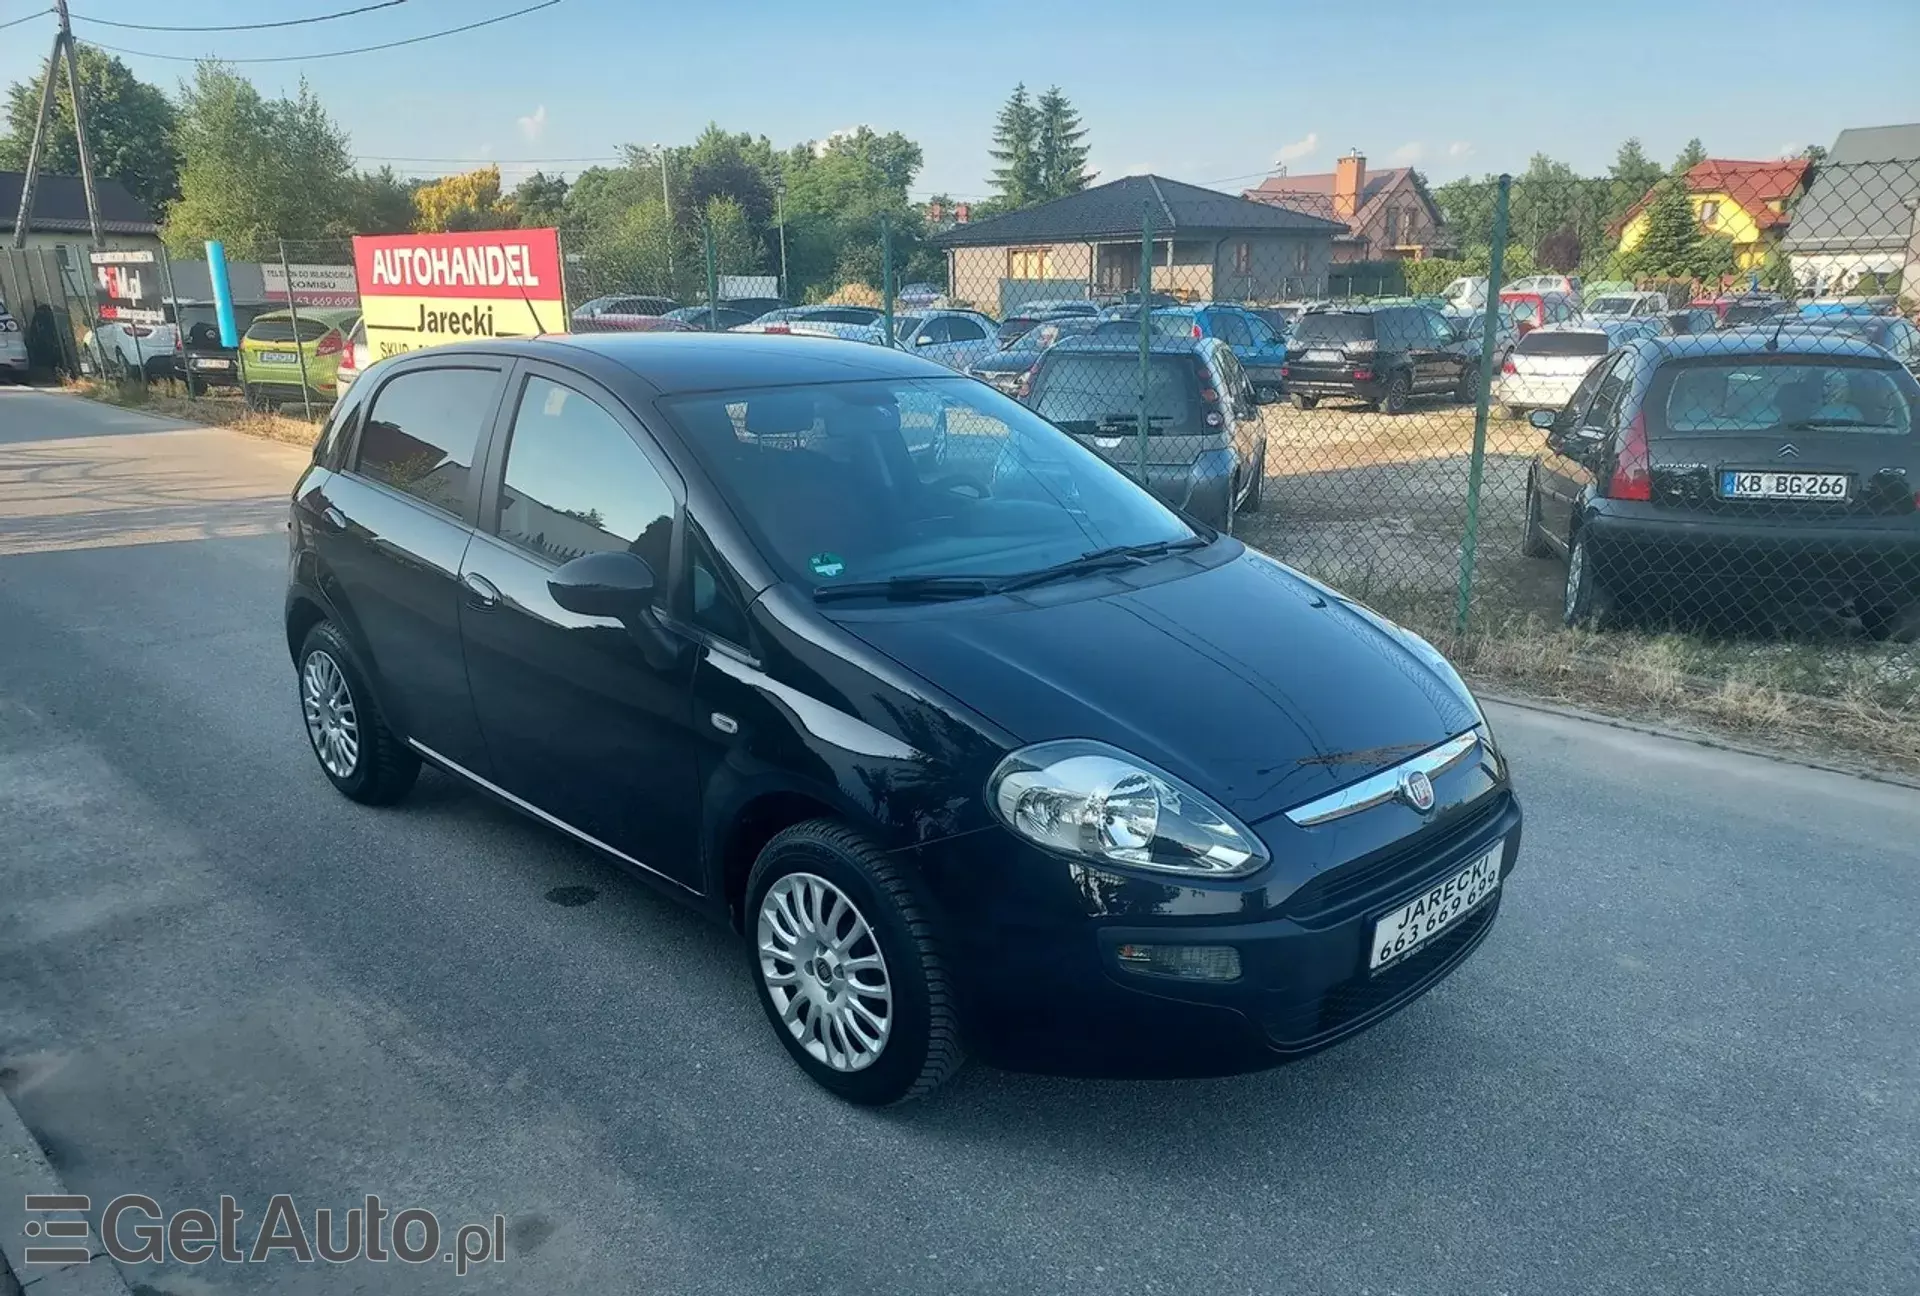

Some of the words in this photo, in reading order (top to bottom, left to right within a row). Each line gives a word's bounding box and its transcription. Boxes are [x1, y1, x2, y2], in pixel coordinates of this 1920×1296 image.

[372, 244, 539, 287] AUTOHANDEL
[335, 296, 354, 306] 699
[417, 304, 493, 337] Jarecki
[1735, 474, 1762, 493] KB
[1806, 477, 1844, 495] 266
[1397, 855, 1489, 930] JARECKI
[1380, 923, 1419, 961] 663
[1426, 896, 1461, 932] 669
[1467, 869, 1495, 906] 699
